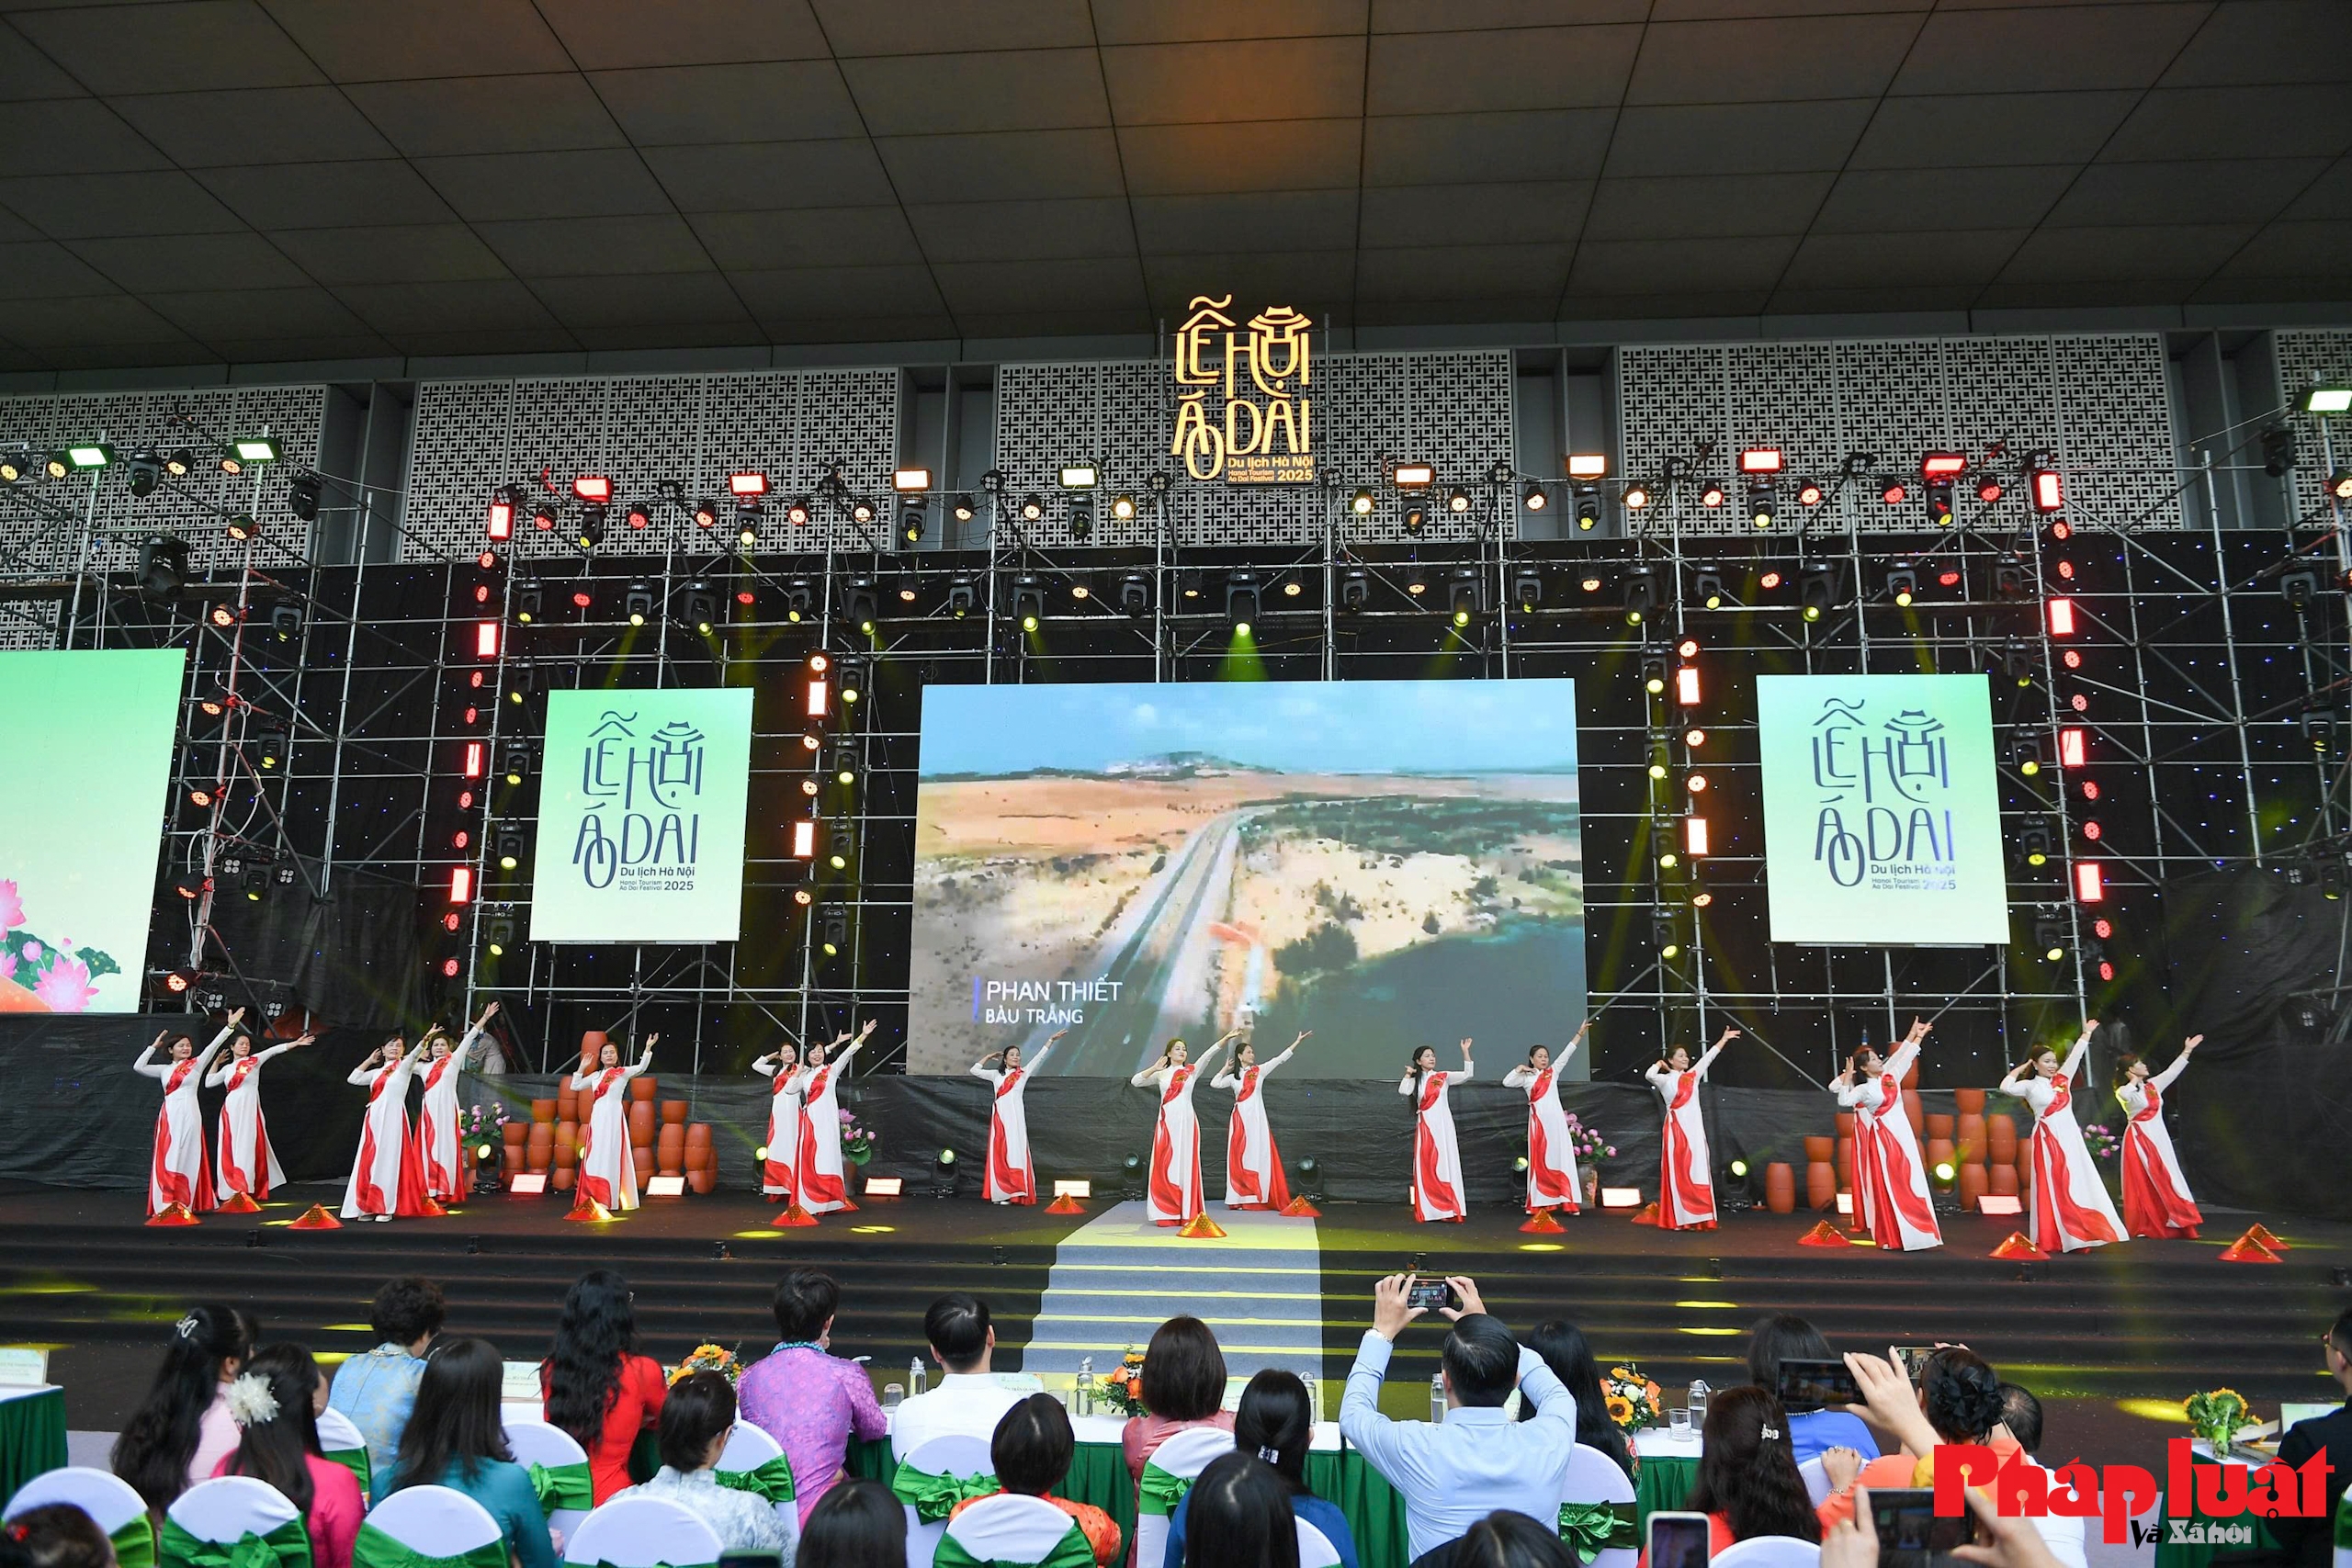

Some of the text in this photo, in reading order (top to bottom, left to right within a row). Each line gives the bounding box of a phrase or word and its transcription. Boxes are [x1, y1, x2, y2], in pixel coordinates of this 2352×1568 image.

[1227, 455, 1314, 470] Du lịch Hà Nội
[1277, 468, 1314, 481] 2025
[620, 866, 695, 878] Du lịch Hà Nội
[1871, 864, 1887, 874] Du
[1890, 863, 1912, 876] lịch
[663, 880, 694, 891] 2025
[987, 974, 1124, 1001] PHAN THIẾT
